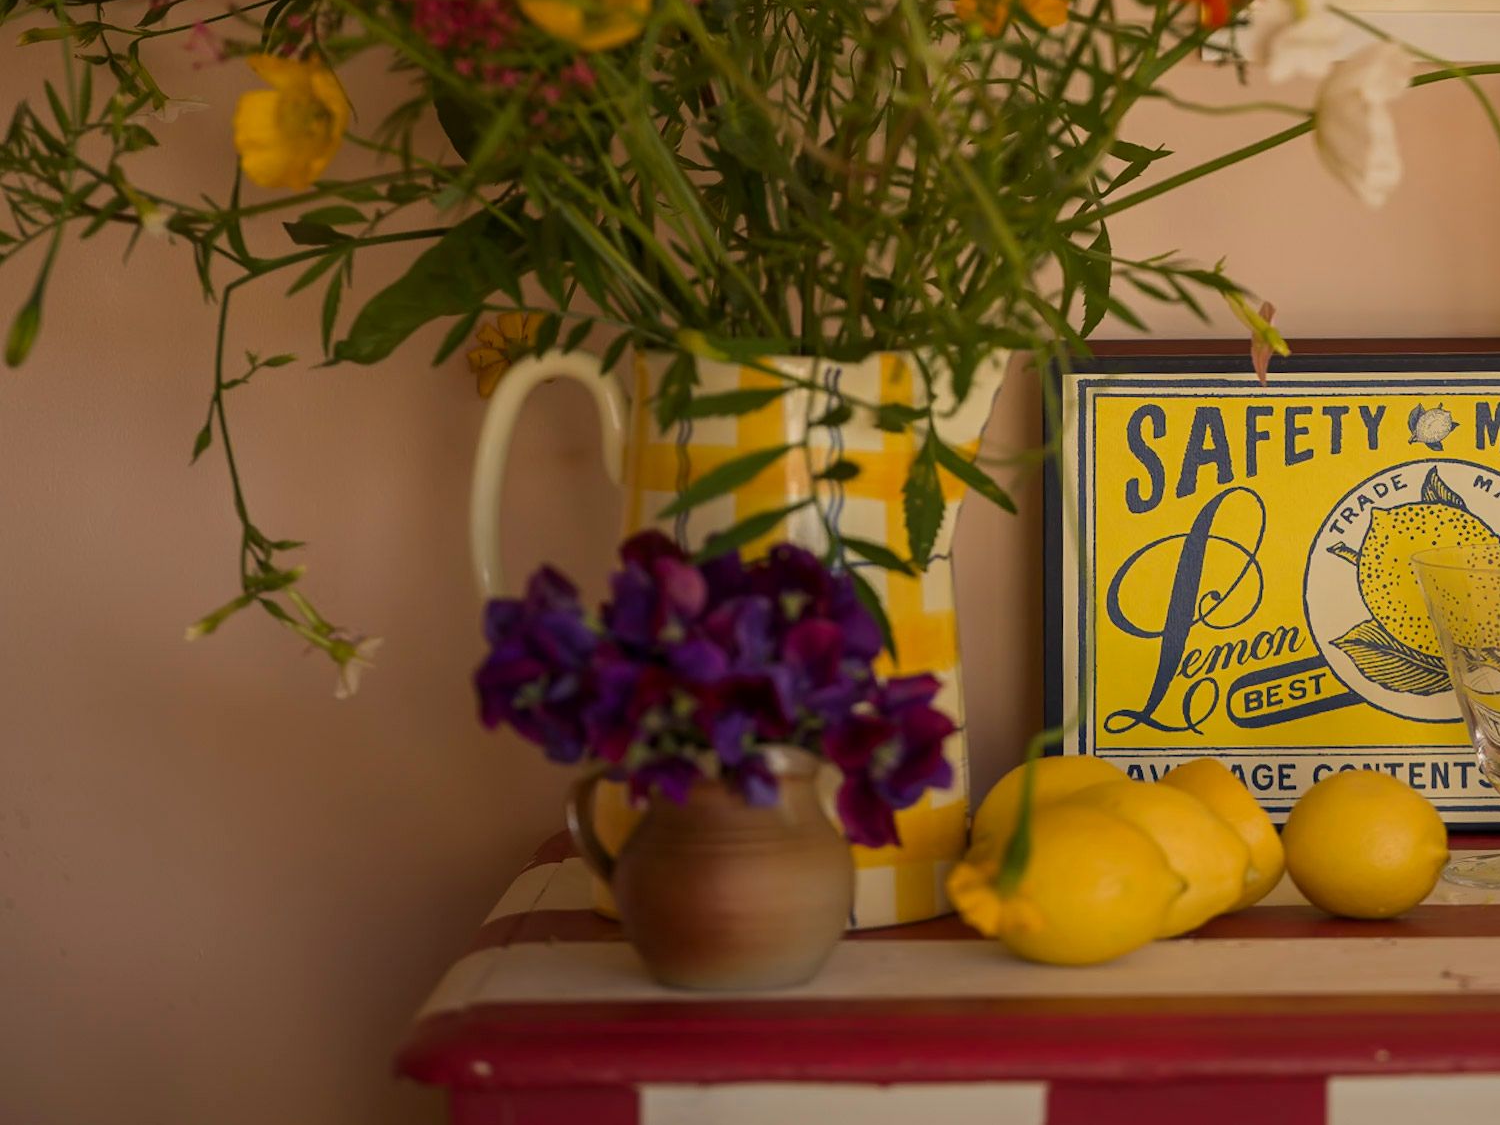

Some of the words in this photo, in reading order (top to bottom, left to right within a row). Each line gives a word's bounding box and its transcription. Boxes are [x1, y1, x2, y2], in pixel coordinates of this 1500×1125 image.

[1125, 403, 1387, 514] SAFETY
[1329, 473, 1409, 535] TRADE
[1103, 485, 1307, 735] Lemon
[1244, 672, 1327, 713] BEST
[1126, 762, 1297, 791] AVAGE
